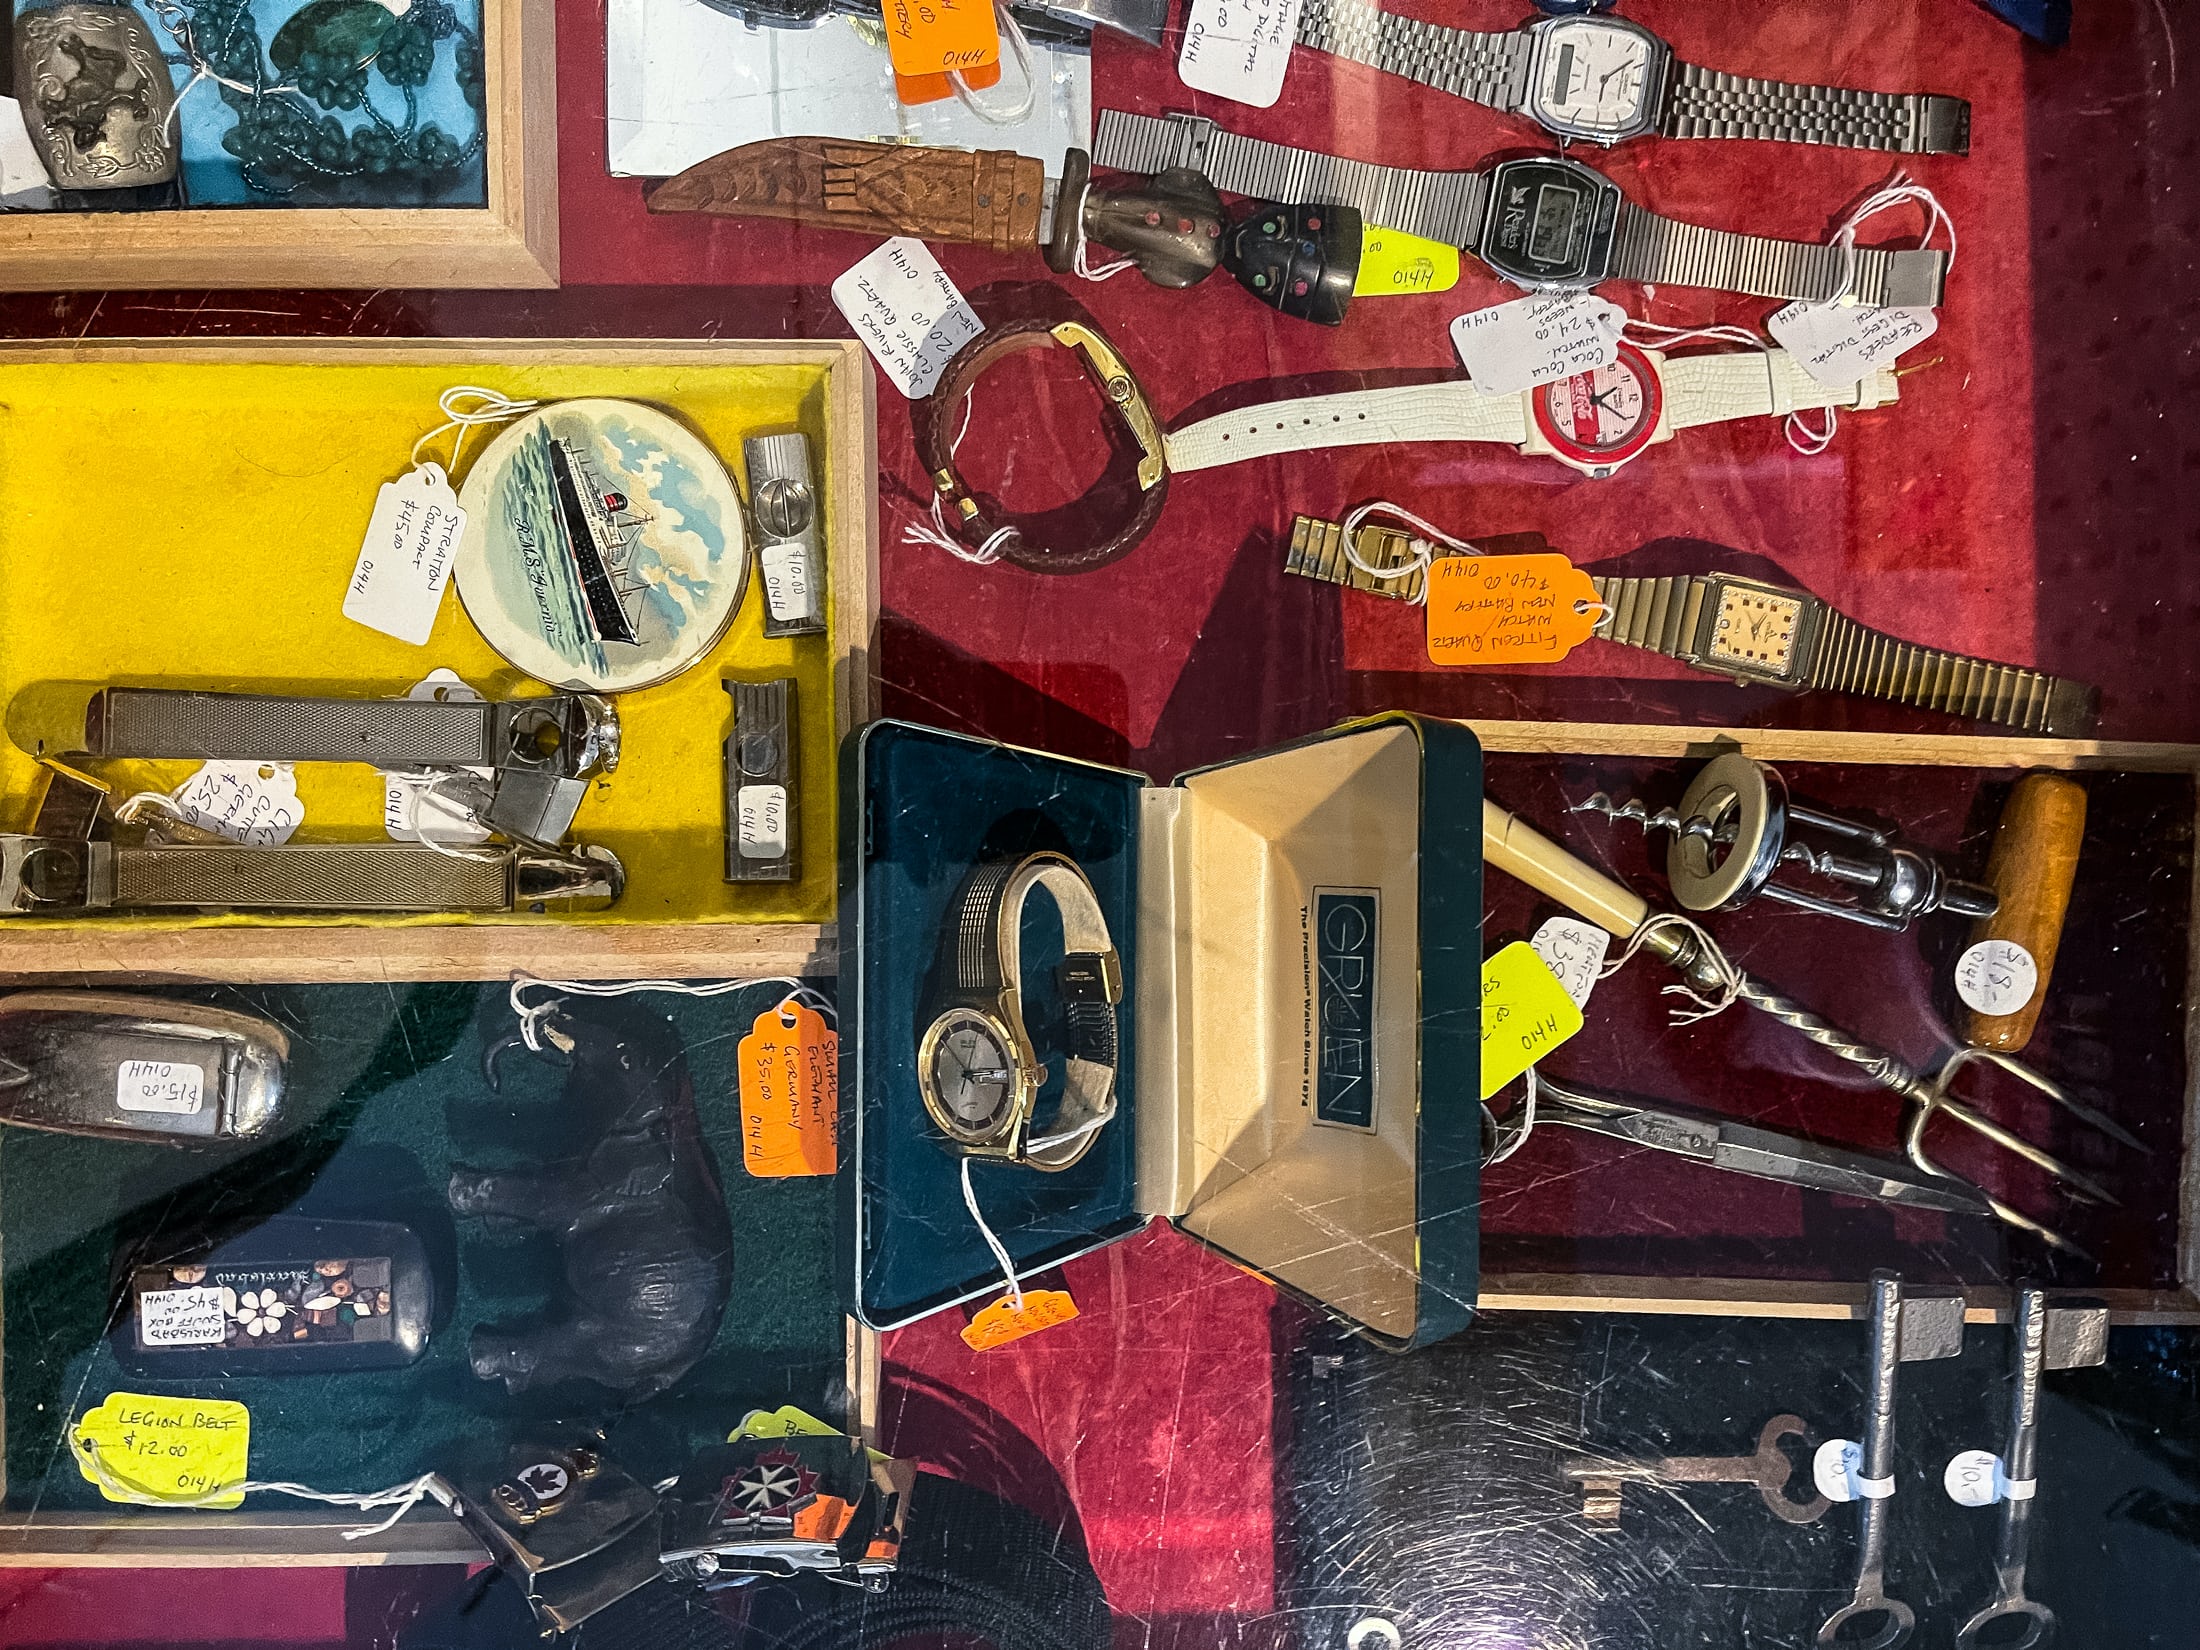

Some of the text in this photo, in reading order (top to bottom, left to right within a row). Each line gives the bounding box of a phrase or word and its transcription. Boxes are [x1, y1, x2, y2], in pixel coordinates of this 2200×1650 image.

[1268, 0, 1292, 45] TAGE
[943, 49, 987, 65] 014H
[1184, 22, 1205, 63] 014H
[888, 248, 918, 279] 014H
[1393, 268, 1434, 290] 014H
[1461, 311, 1499, 329] 014H
[353, 560, 374, 594] 014H
[788, 550, 807, 594] $10.00
[1442, 560, 1479, 578] 014H
[768, 577, 786, 609] 014H
[385, 790, 402, 830] 014H
[739, 808, 757, 844] 014H
[765, 792, 785, 833] $10.00
[254, 808, 291, 848] CIG
[1300, 906, 1308, 929] The
[1303, 998, 1312, 1037] Watch
[1325, 904, 1367, 1115] GRUEN
[1521, 1013, 1558, 1050] 014H
[129, 1062, 171, 1078] 014H
[142, 1083, 198, 1112] $15.00
[145, 1292, 175, 1304] 014H
[151, 1328, 222, 1340] KARLSBAD
[119, 1408, 238, 1431] LEGION BELT
